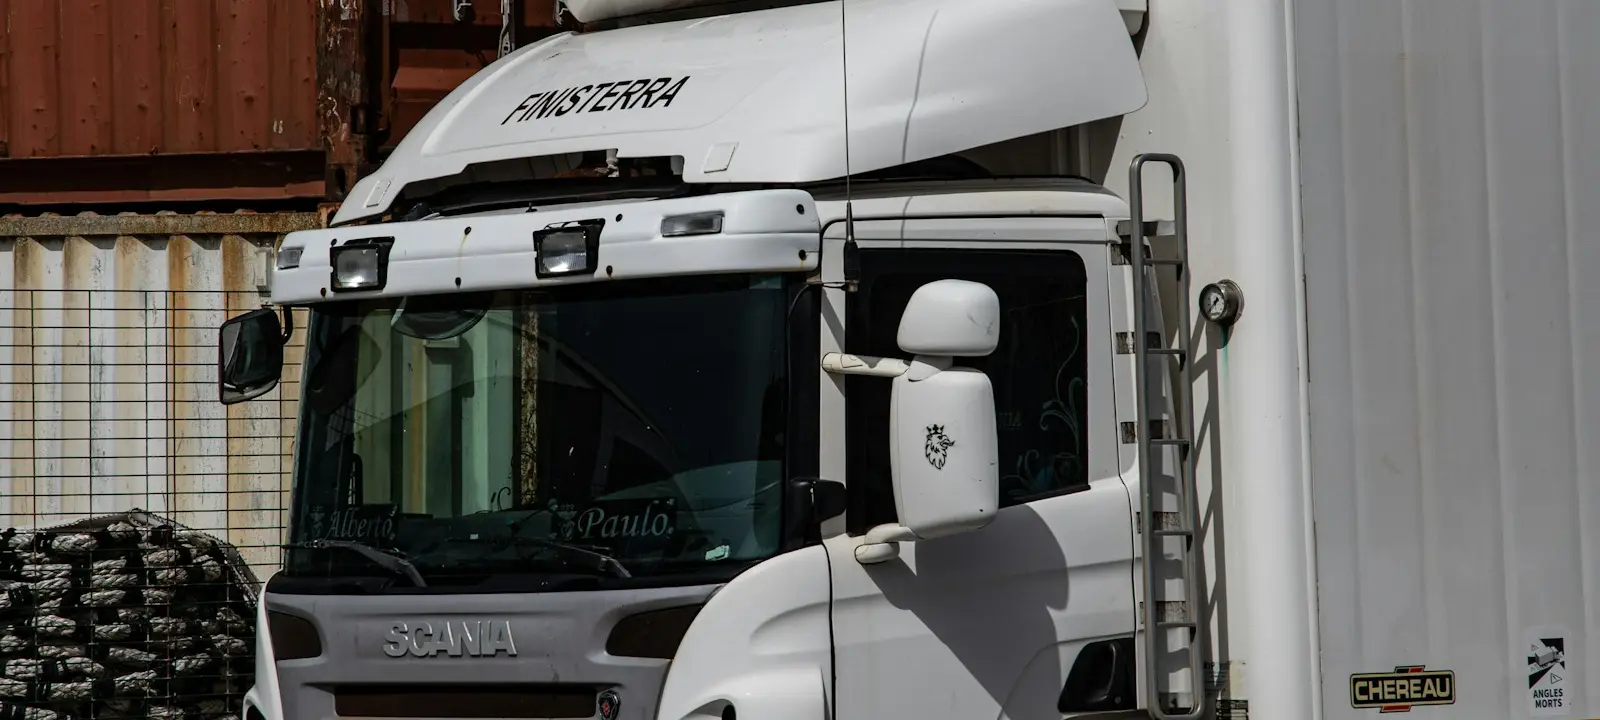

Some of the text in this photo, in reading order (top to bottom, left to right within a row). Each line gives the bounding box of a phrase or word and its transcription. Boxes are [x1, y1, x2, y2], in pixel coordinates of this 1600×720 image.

[501, 76, 690, 125] FINISTERRA
[325, 507, 393, 540] Alberto
[578, 503, 669, 539] Paulo
[383, 620, 518, 657] SCANIA
[1355, 677, 1450, 701] CHEREAU
[1533, 689, 1563, 698] ANGLES
[1535, 699, 1563, 708] MORTS
